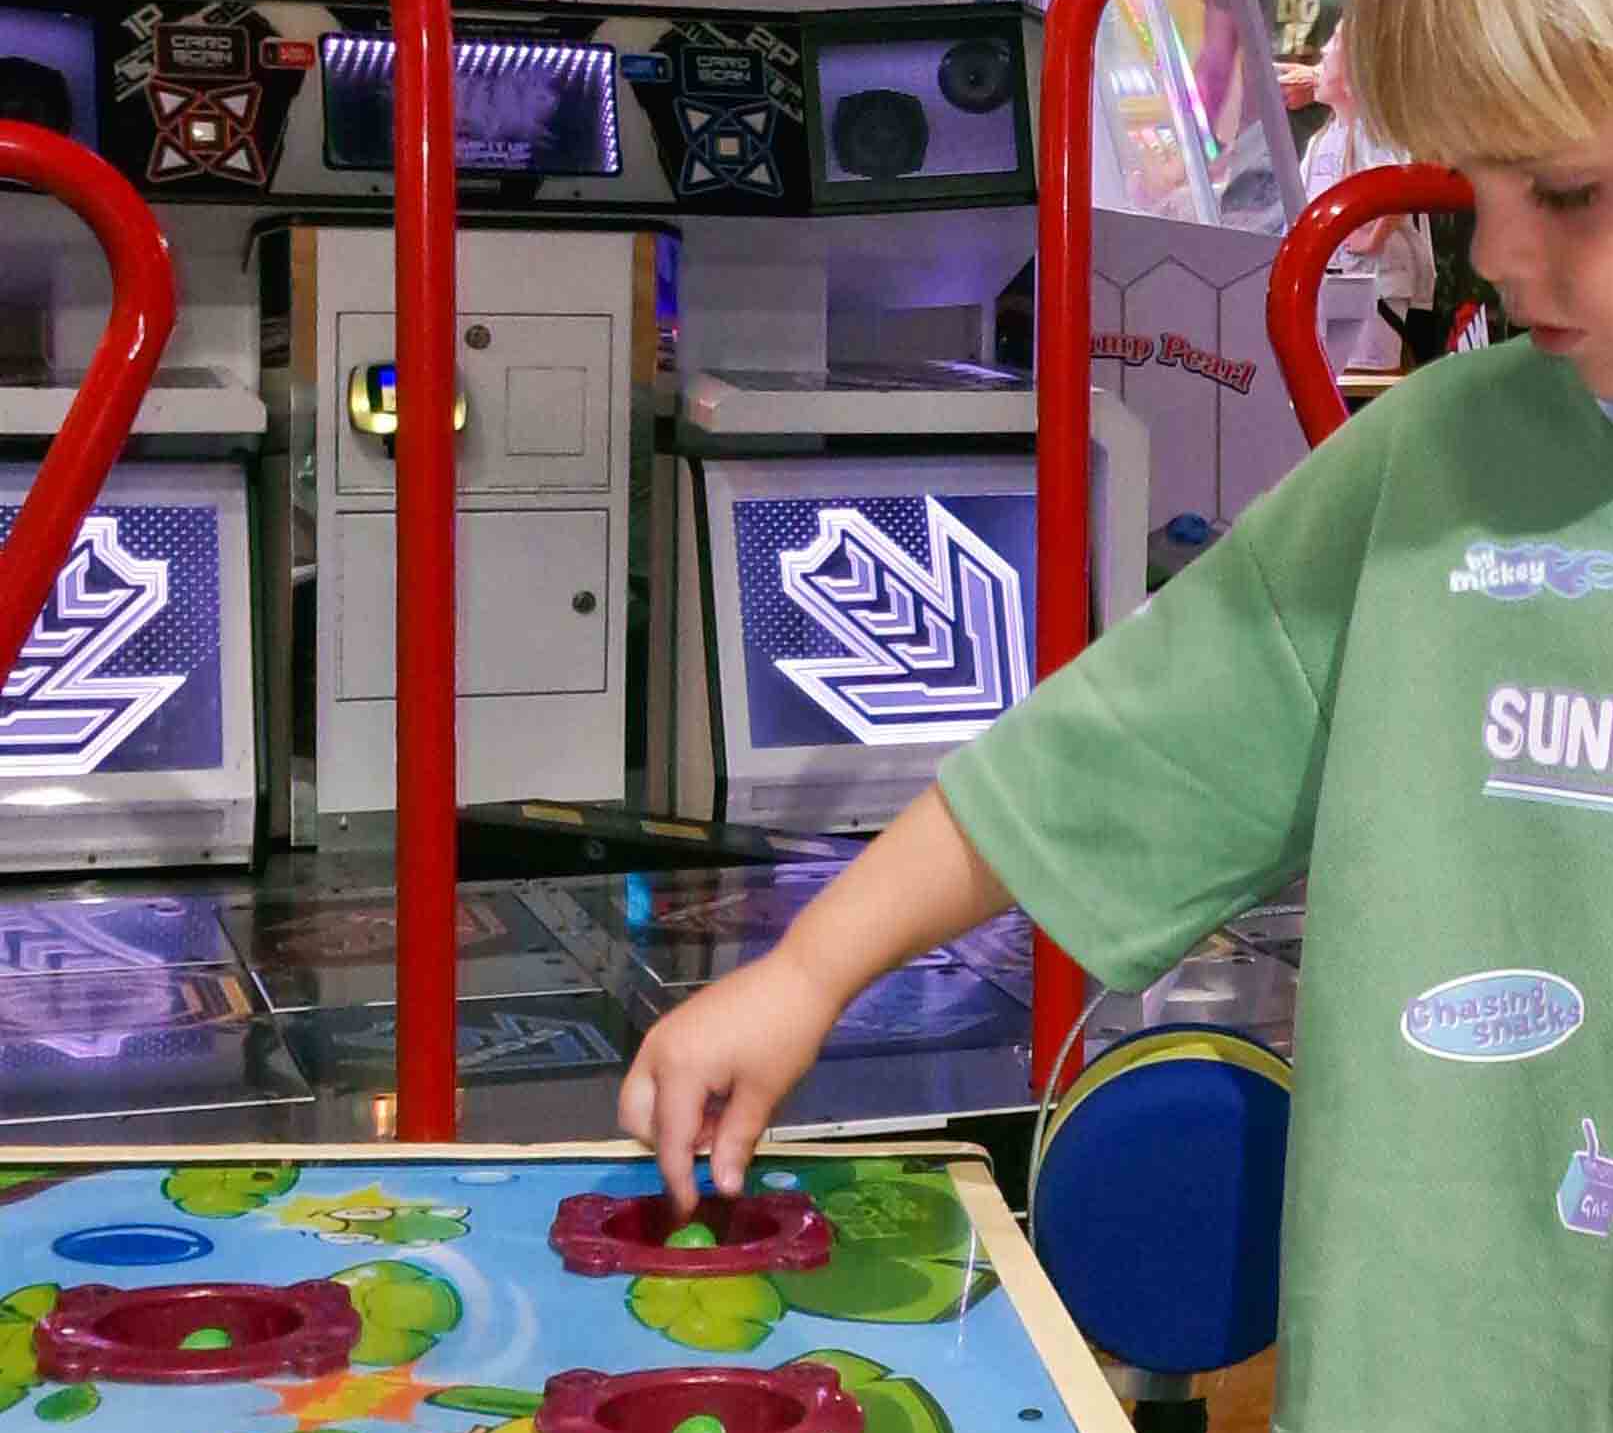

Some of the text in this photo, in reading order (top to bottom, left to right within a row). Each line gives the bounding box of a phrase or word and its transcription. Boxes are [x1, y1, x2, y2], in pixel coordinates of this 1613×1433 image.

[1156, 332, 1257, 395] Pearl
[1449, 561, 1545, 593] mickey
[1408, 978, 1549, 1032] Chasing
